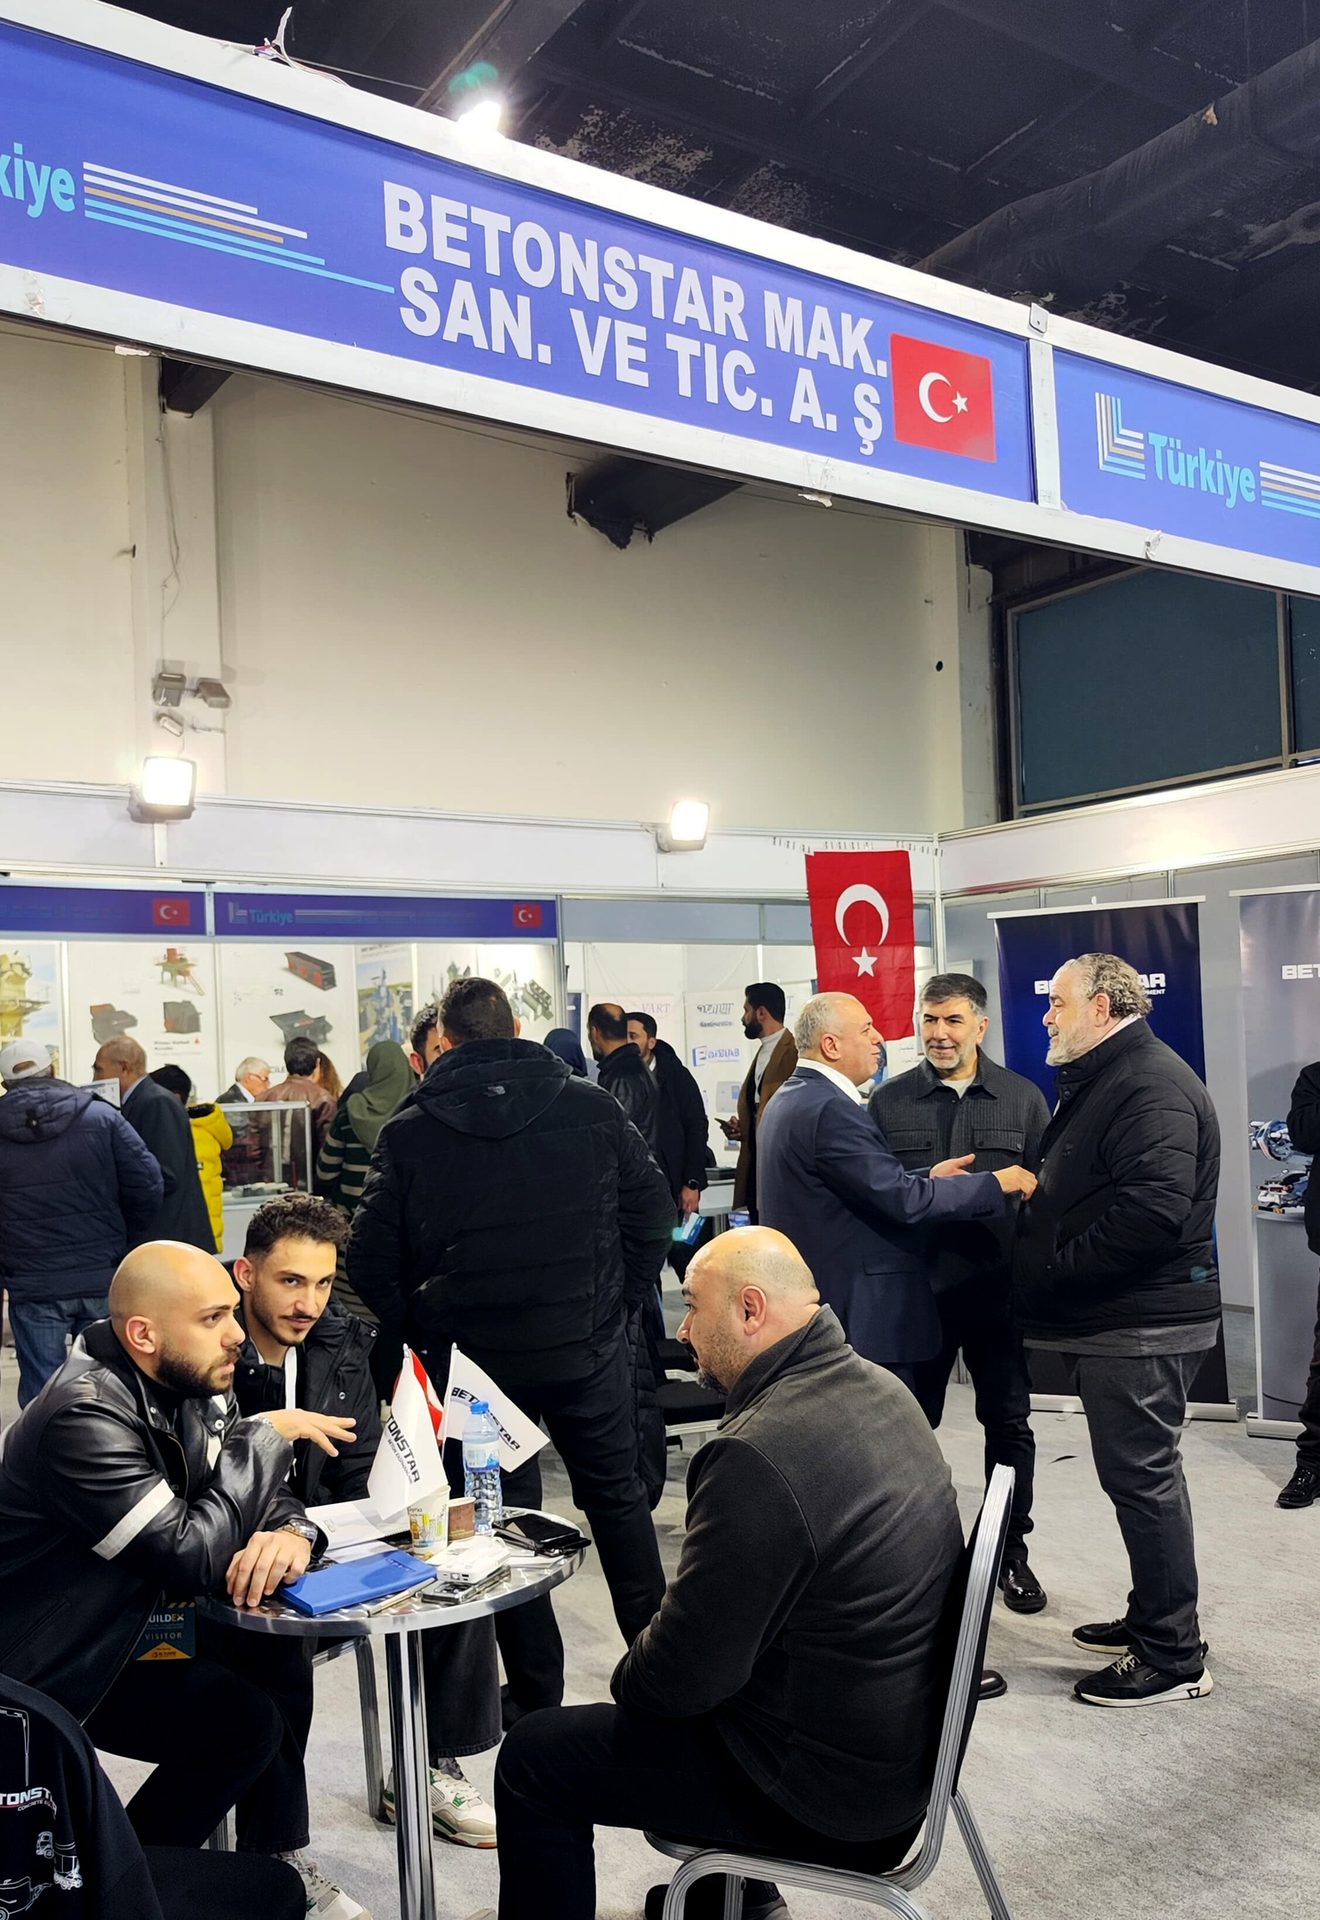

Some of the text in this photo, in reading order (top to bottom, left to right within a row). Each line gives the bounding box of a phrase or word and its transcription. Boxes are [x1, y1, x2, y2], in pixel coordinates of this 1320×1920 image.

[383, 181, 888, 377] BETONSTAR MAK.
[400, 267, 883, 456] SAN. VE TIC. A. Ş
[1148, 432, 1256, 509] Türkiye
[249, 908, 294, 925] Türkiye
[145, 1632, 182, 1640] VISITOR
[149, 1614, 184, 1623] UILDEX
